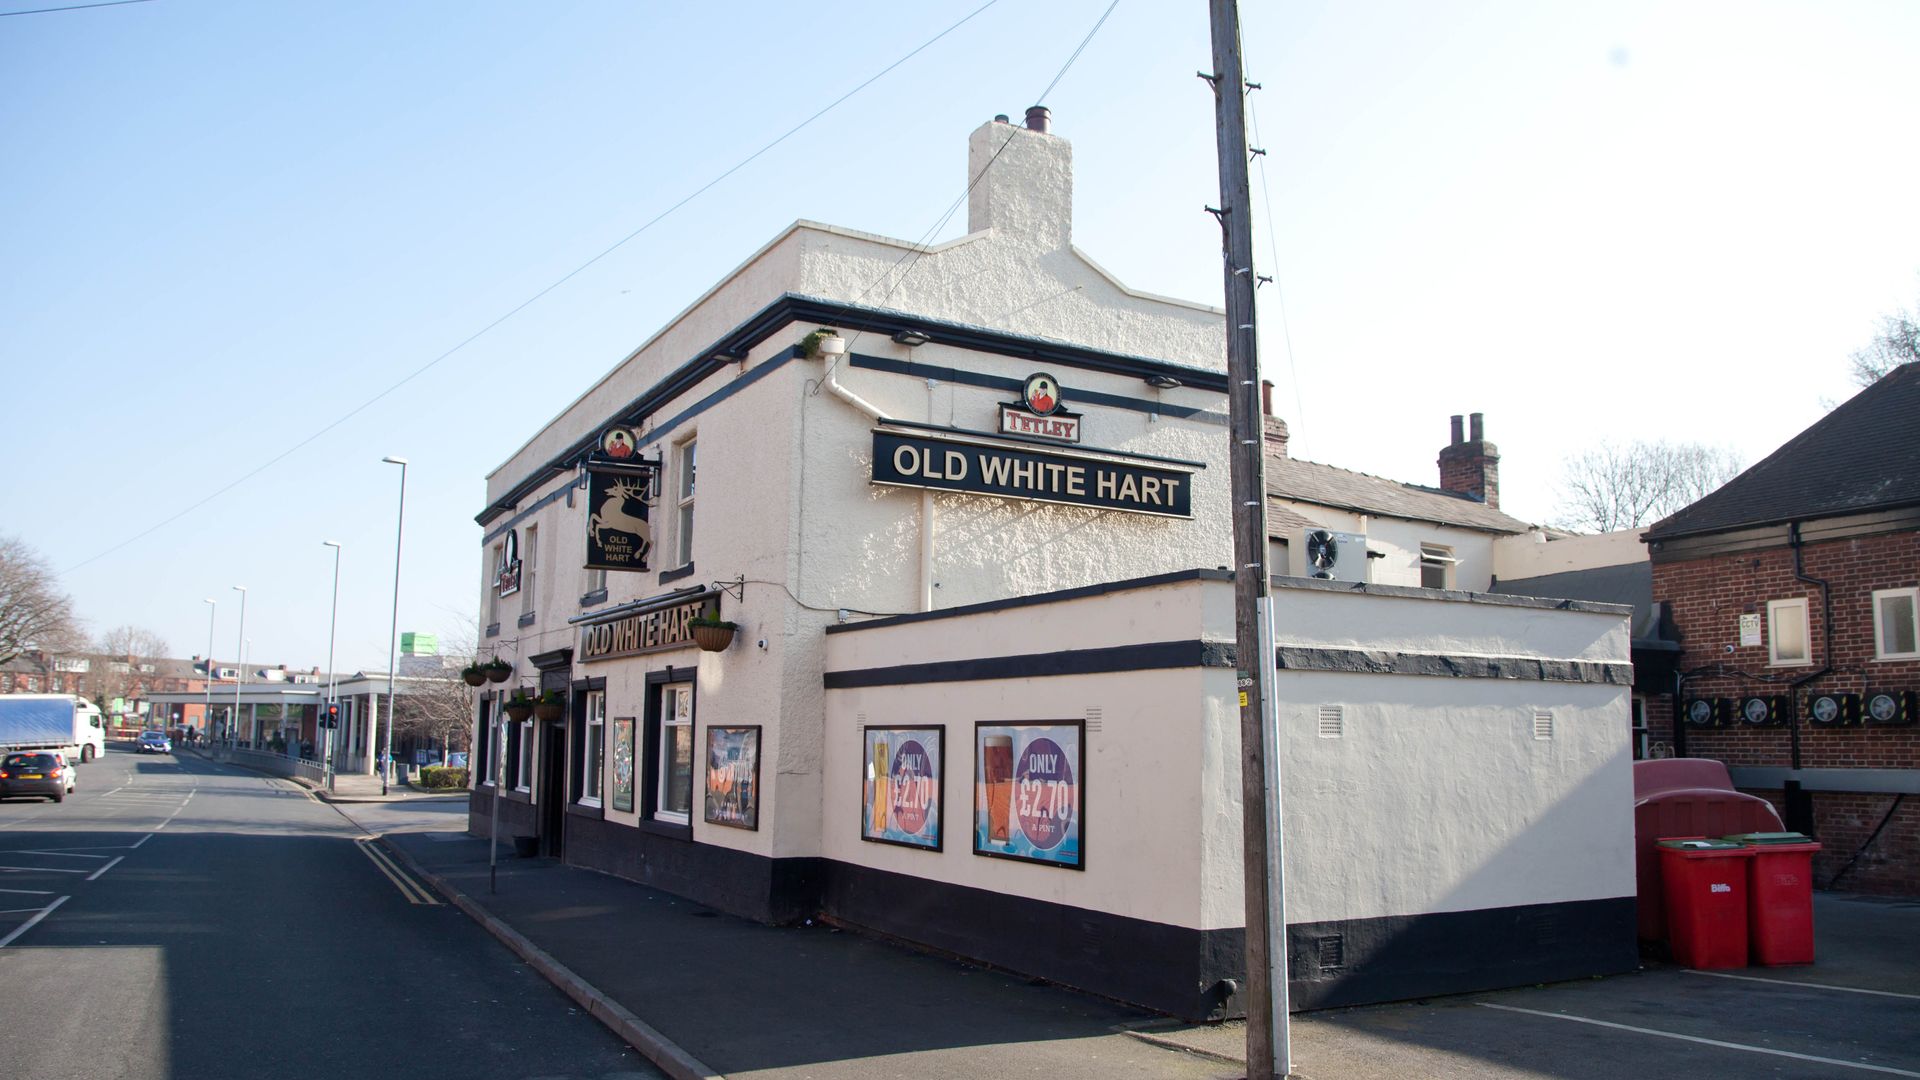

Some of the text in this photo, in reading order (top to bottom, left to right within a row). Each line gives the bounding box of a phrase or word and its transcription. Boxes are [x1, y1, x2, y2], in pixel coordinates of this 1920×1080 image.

[1006, 411, 1076, 438] TETLEY
[893, 445, 1180, 507] OLD WHITE HART
[604, 544, 633, 554] WHITE
[609, 535, 628, 544] OLD
[605, 554, 631, 562] HART
[585, 623, 611, 656] OLD
[613, 613, 656, 652] WHITE
[901, 753, 922, 770] ONLY
[1029, 753, 1058, 773] ONLY
[894, 774, 929, 810] £2.70
[1019, 778, 1068, 820] £2.70
[1031, 823, 1055, 833] A PINT
